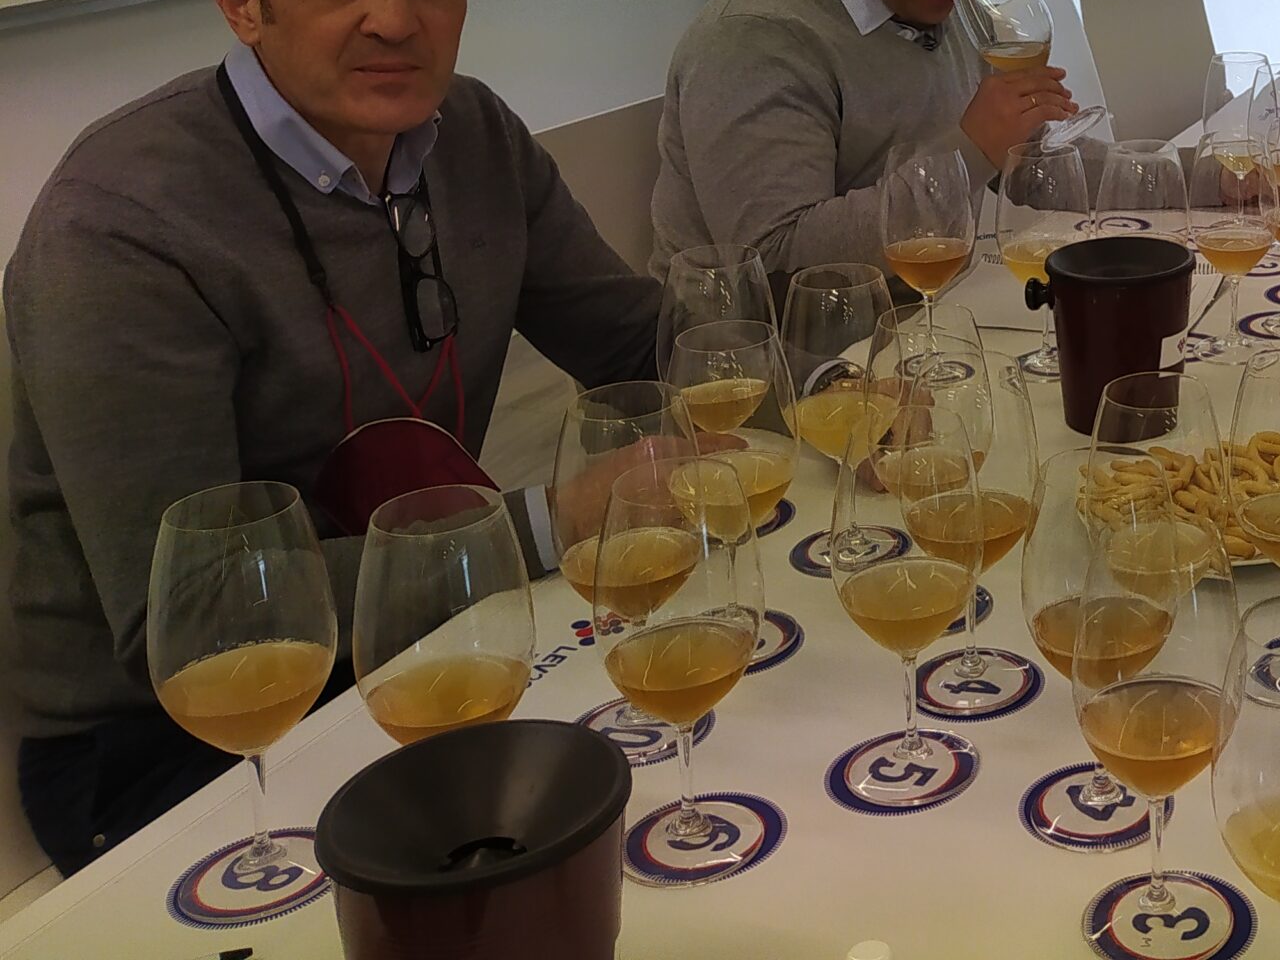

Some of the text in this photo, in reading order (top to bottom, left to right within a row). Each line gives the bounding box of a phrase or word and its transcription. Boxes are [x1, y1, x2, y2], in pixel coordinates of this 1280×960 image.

[868, 756, 939, 787] 5
[221, 855, 304, 891] 8
[1131, 906, 1211, 941] 3
